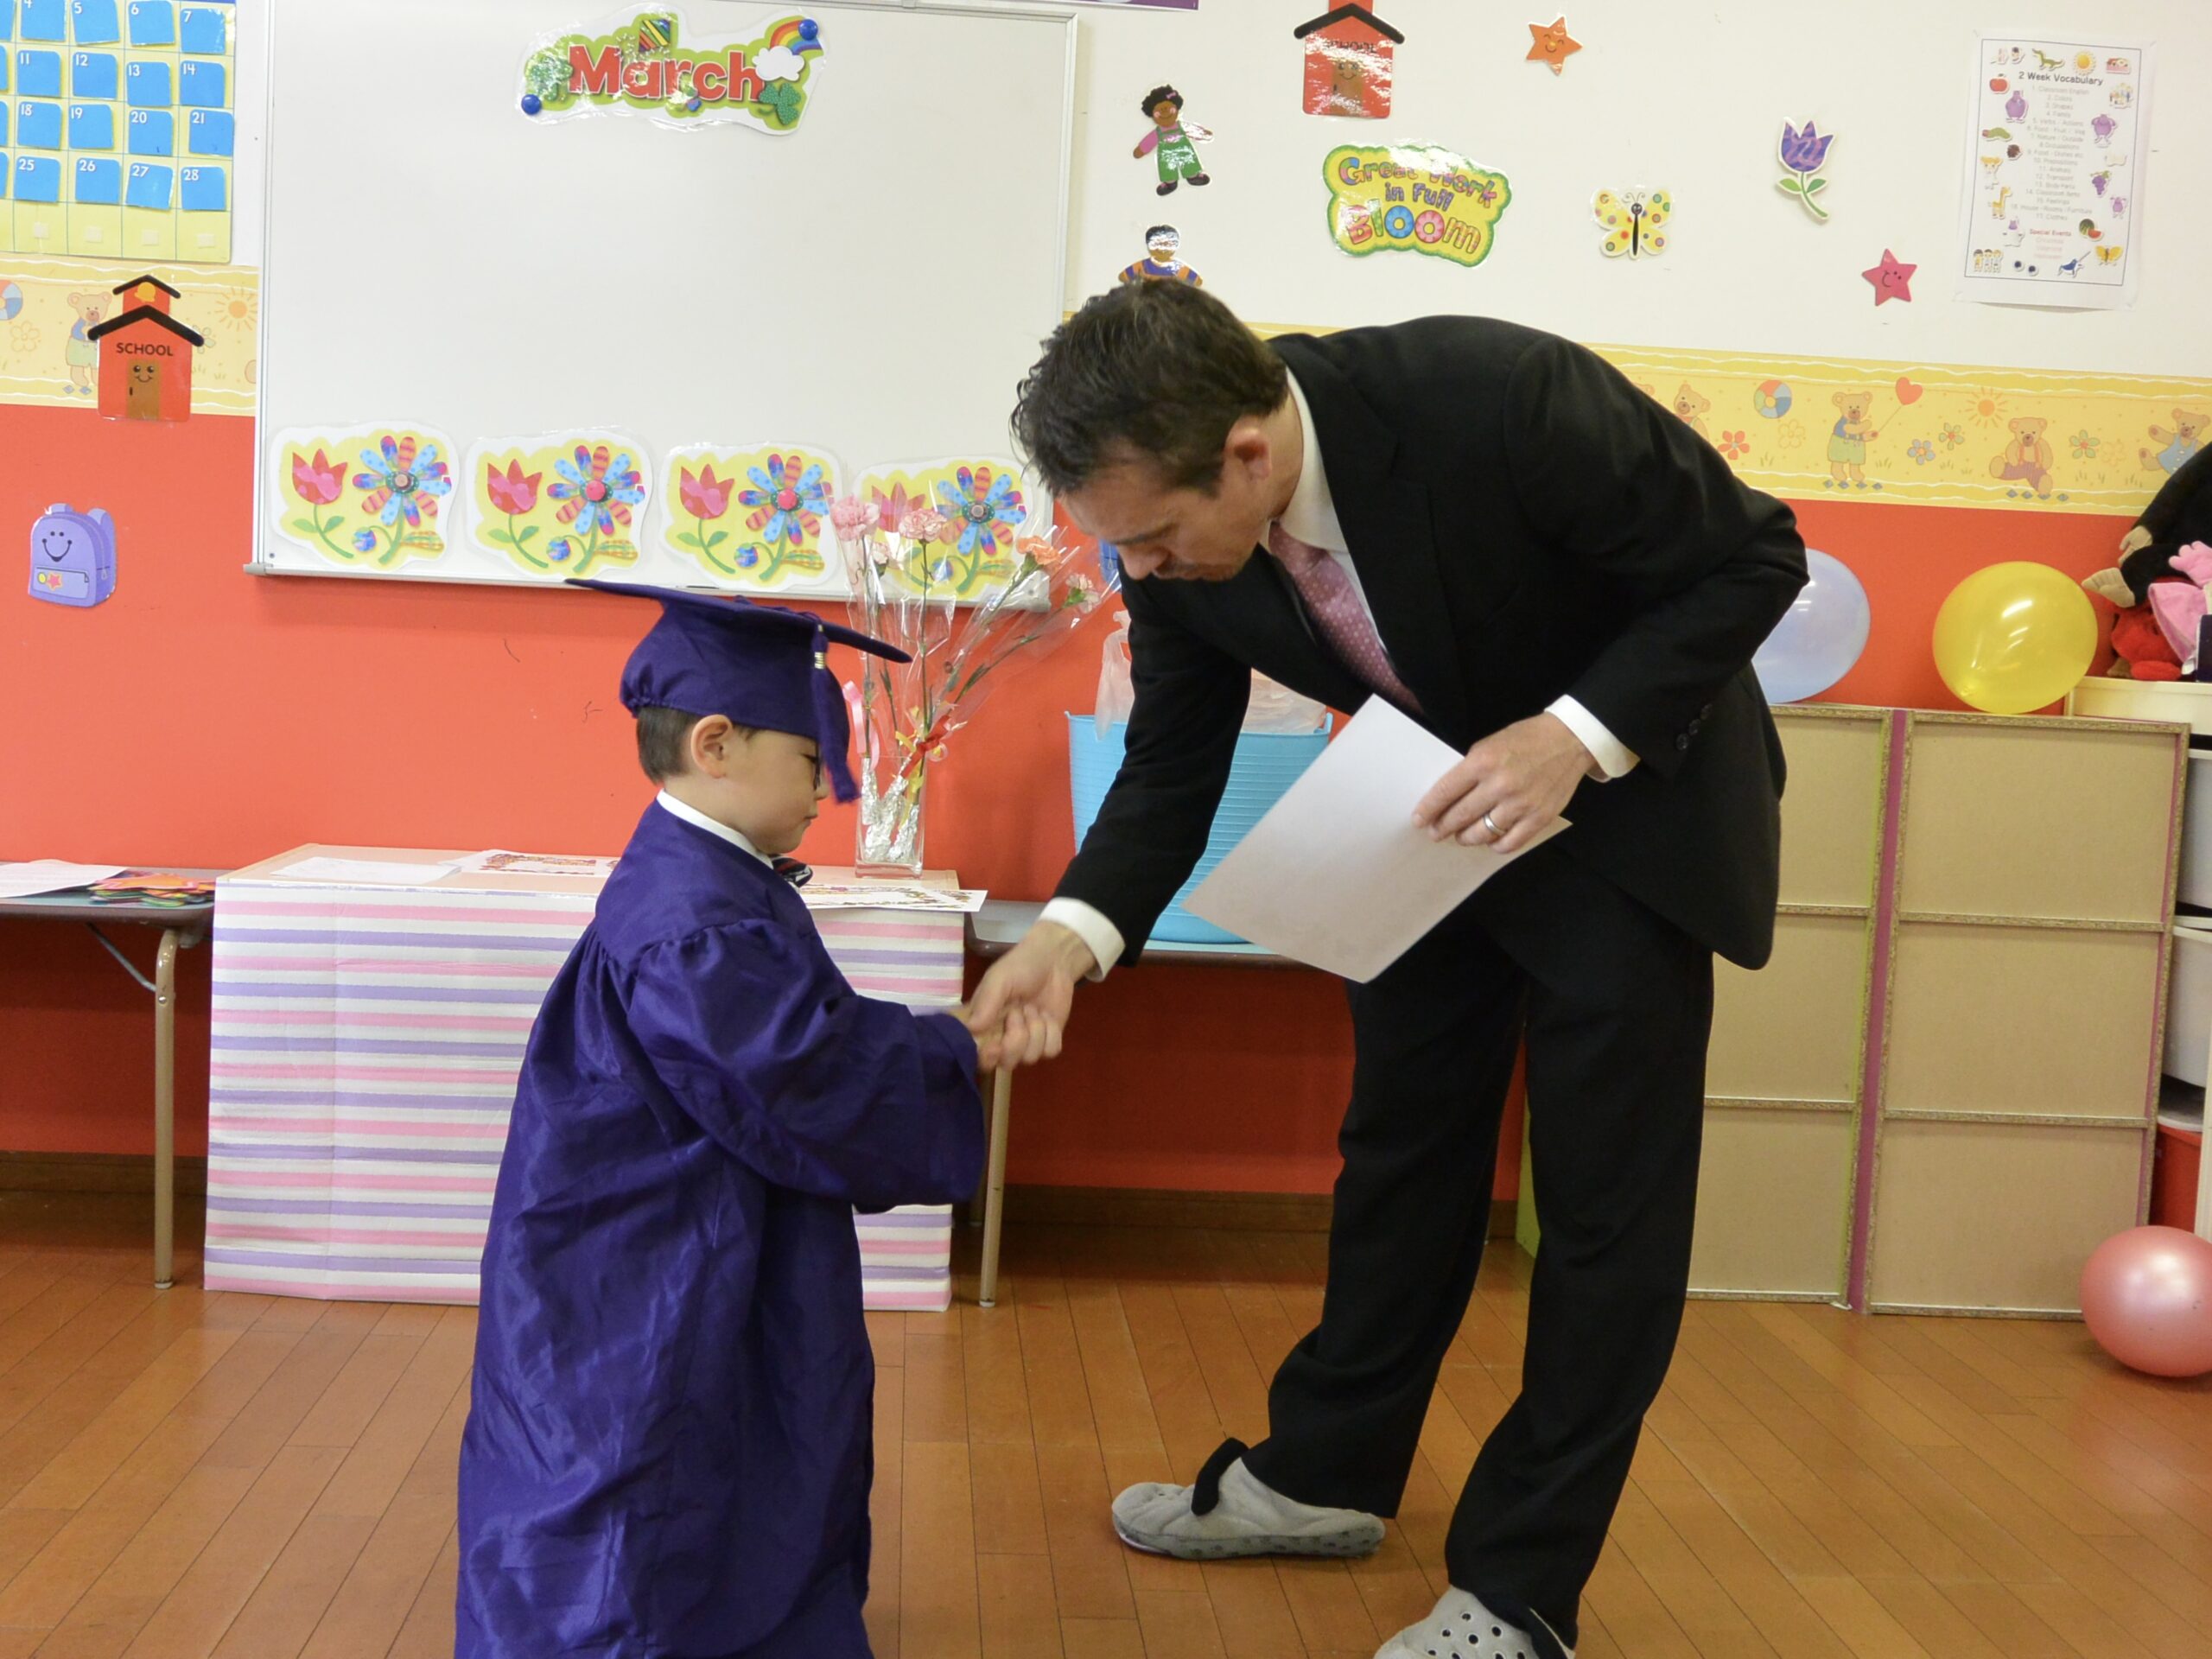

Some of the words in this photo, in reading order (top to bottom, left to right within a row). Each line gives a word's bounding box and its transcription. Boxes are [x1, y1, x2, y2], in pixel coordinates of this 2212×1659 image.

[23, 0, 32, 9] 4
[74, 2, 82, 15] 5
[130, 3, 139, 16] 6
[184, 10, 192, 22] 7
[1322, 40, 1378, 54] CHOOL
[20, 53, 29, 65] 11
[75, 54, 88, 67] 12
[128, 64, 141, 77] 13
[182, 63, 196, 76] 14
[568, 43, 766, 102] March
[2027, 72, 2050, 81] Week
[2054, 74, 2103, 86] Vocabulary
[21, 104, 33, 116] 18
[71, 107, 83, 119] 19
[131, 111, 147, 124] 20
[192, 112, 205, 124] 21
[18, 159, 35, 171] 25
[79, 160, 96, 172] 26
[132, 165, 149, 177] 27
[183, 169, 200, 181] 28
[1384, 181, 1405, 202] in
[1413, 182, 1455, 212] Full
[116, 342, 174, 357] SCHOOL
